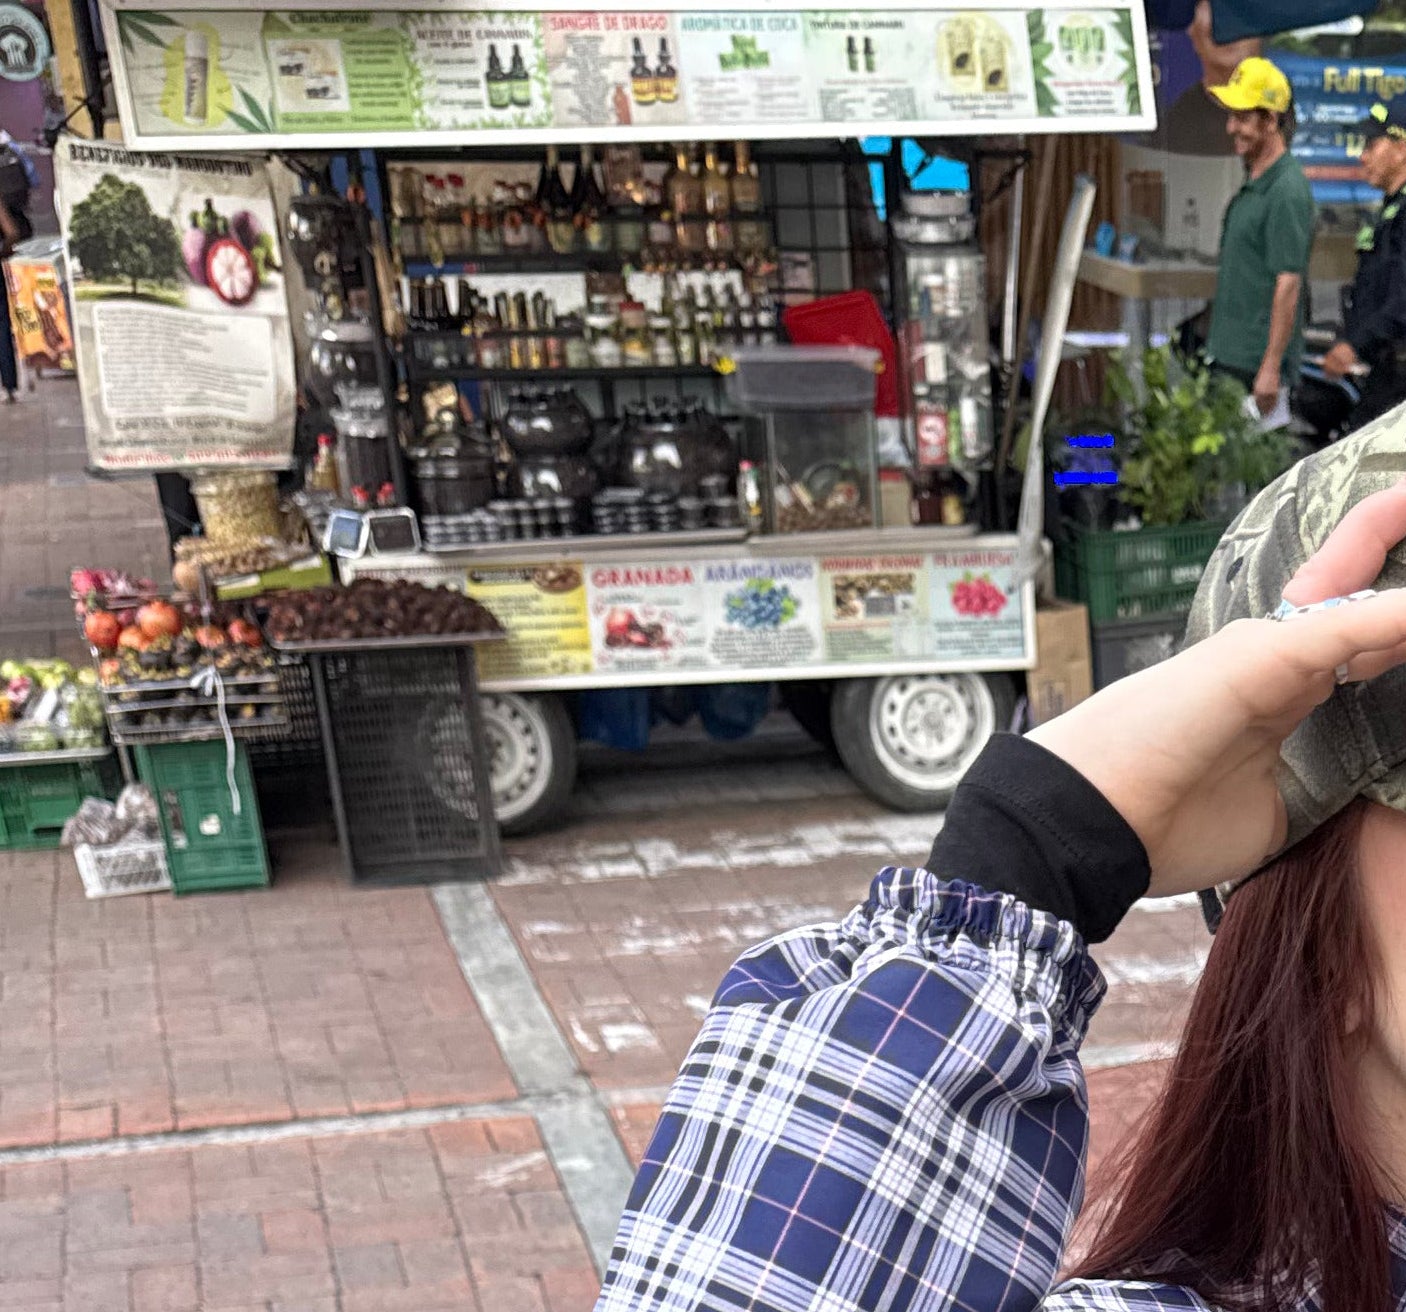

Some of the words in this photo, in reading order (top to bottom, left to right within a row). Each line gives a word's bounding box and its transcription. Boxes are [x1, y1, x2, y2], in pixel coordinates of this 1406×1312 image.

[550, 14, 600, 31] SANGRE
[603, 14, 618, 31] DE
[622, 14, 667, 31] DRAGO
[749, 16, 765, 32] DE
[767, 16, 798, 31] COCA
[1323, 66, 1361, 93] Full
[591, 565, 696, 589] GRANADA
